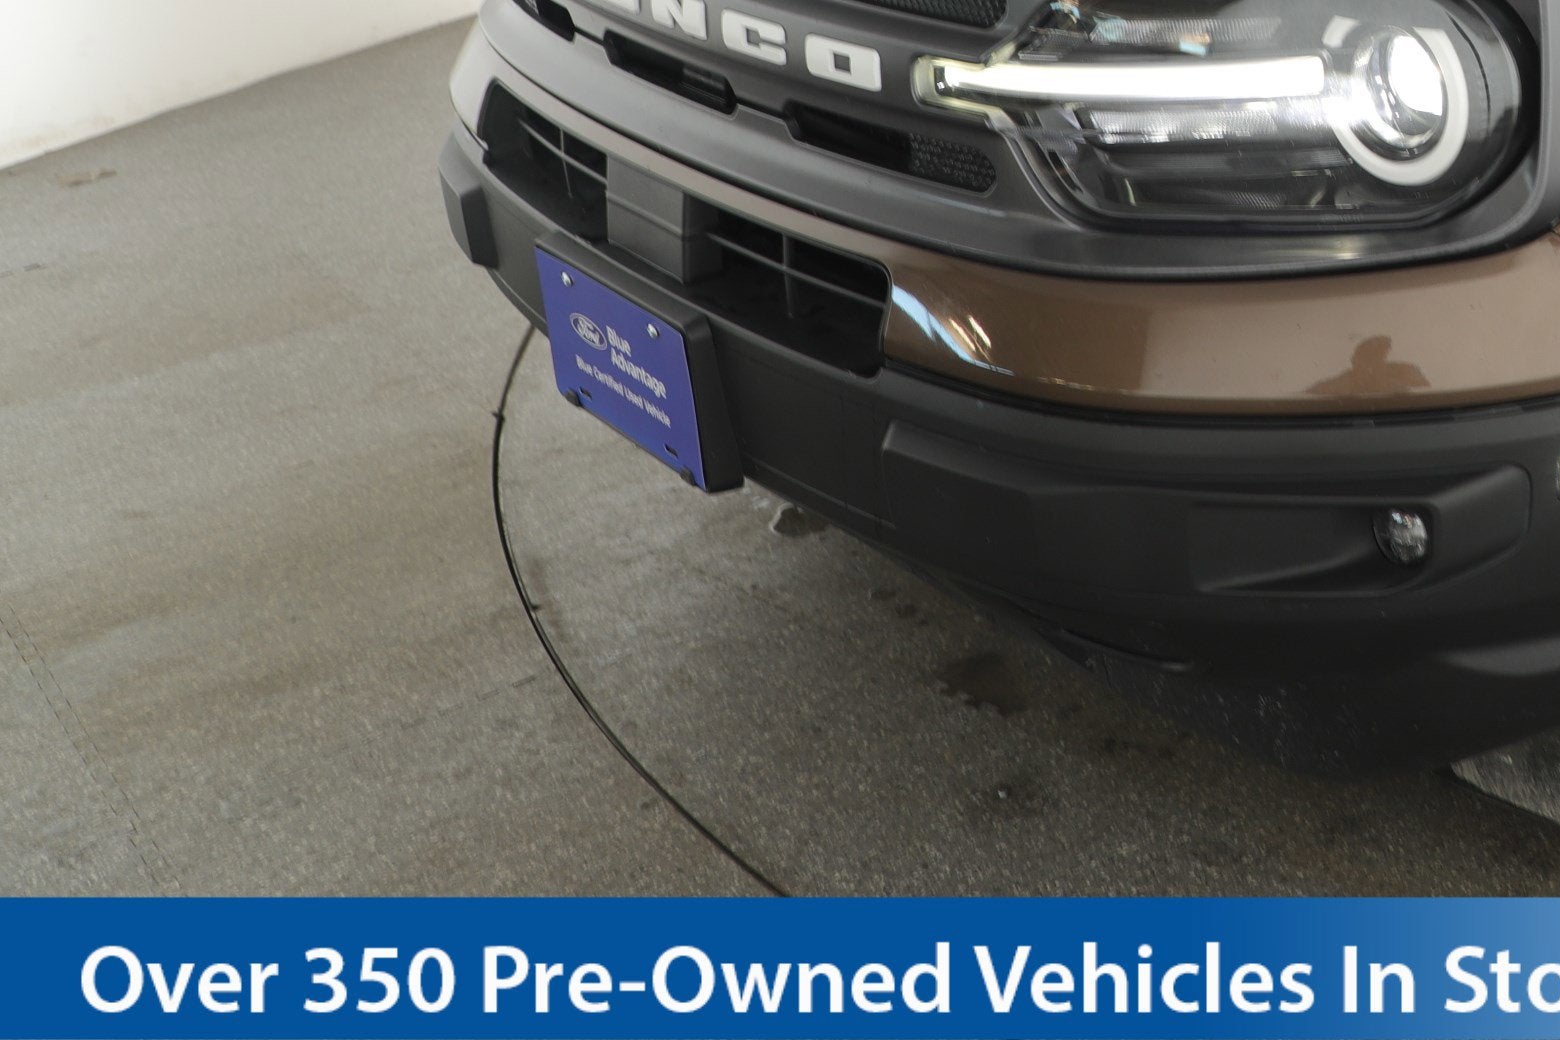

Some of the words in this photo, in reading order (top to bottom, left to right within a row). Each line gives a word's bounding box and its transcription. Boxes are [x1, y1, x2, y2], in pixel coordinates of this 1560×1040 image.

[606, 325, 632, 358] Blue
[576, 354, 595, 377] Blue
[592, 365, 625, 397] Certified
[624, 385, 644, 410] Used
[642, 397, 671, 429] Vehicle
[611, 347, 667, 399] Advantage
